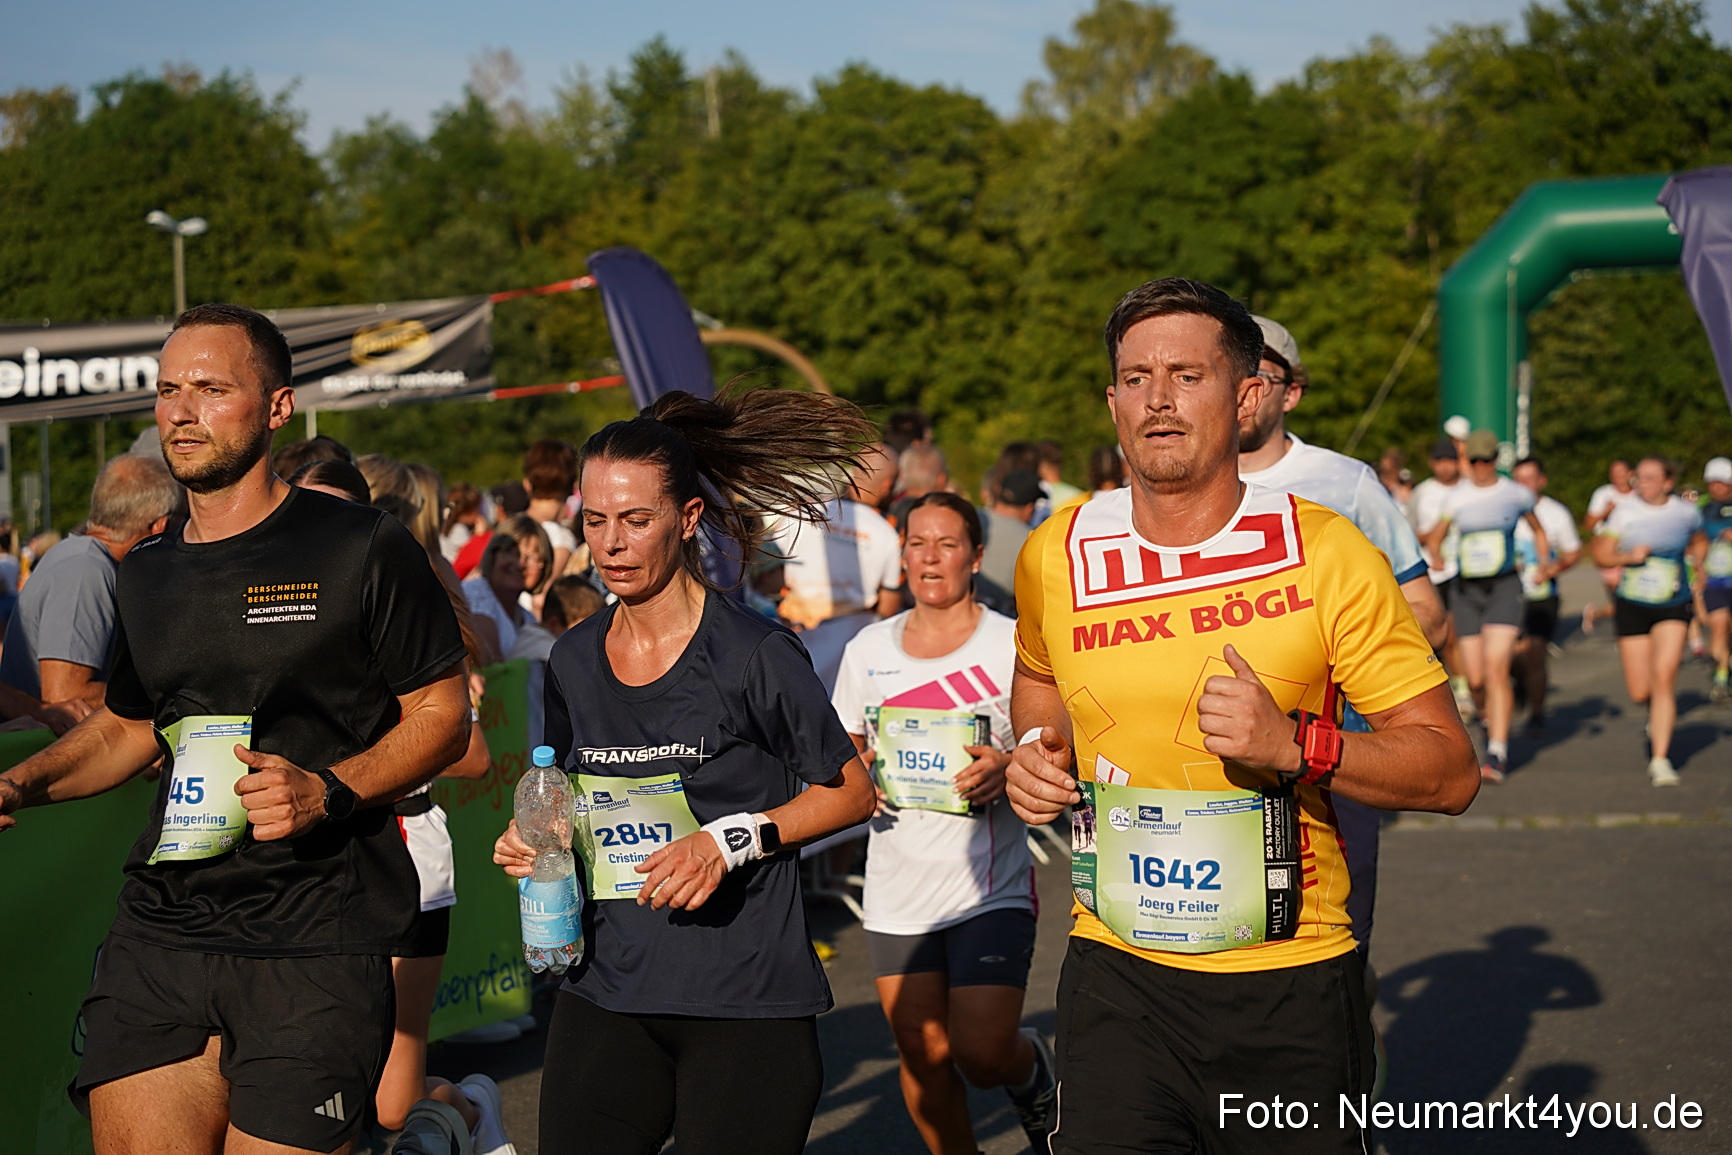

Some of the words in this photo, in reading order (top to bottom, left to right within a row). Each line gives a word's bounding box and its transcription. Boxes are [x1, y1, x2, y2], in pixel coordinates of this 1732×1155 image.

[248, 583, 318, 593] BERSCHNEIDER
[248, 592, 317, 603] BERSCHNEIDER
[247, 605, 299, 615] ARCHITEKTEN
[247, 614, 316, 624] INNENARCHITEKTEN
[1073, 611, 1176, 653] MAX
[1190, 584, 1314, 634] BÖGL
[897, 750, 946, 771] 1954
[590, 798, 629, 811] Firmenlauf
[173, 813, 227, 826] Ingerling
[1133, 820, 1182, 830] Firmenlauf
[594, 823, 672, 847] 2847
[608, 853, 650, 864] Cristina
[1266, 846, 1273, 859] 20
[1129, 853, 1222, 891] 1642
[1138, 895, 1175, 914] Joerg
[1178, 900, 1220, 913] Feiler
[1272, 893, 1283, 934] HILTL
[1135, 931, 1186, 941] firmenlauf.bayern
